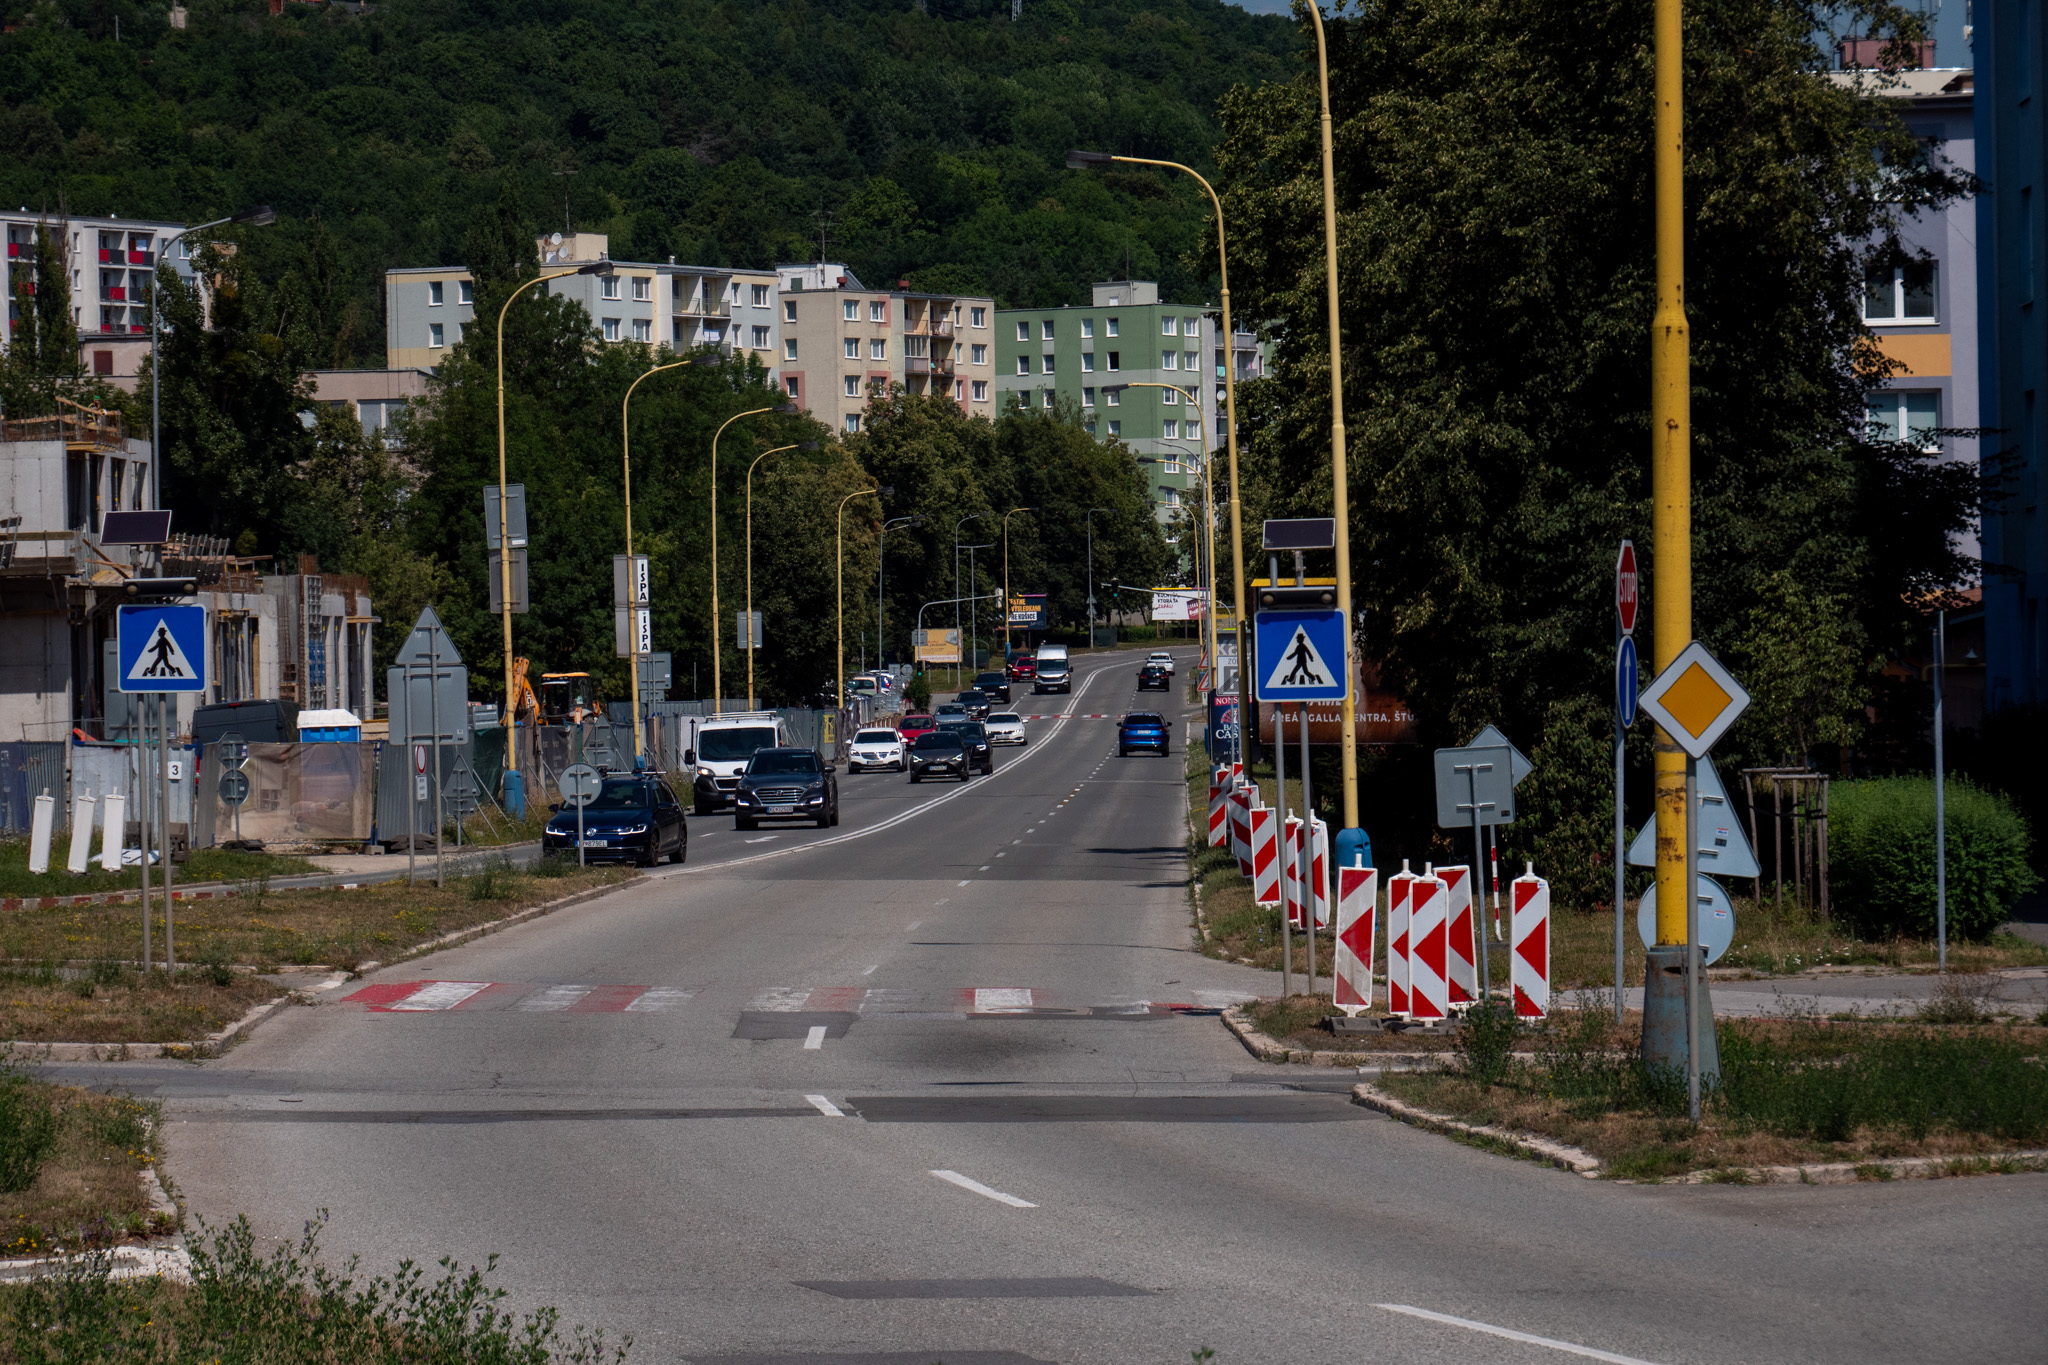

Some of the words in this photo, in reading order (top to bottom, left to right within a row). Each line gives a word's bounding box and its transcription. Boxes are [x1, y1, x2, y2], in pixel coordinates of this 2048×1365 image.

[1620, 571, 1636, 603] STOP
[641, 615, 649, 651] ISPA
[1308, 713, 1342, 722] GALLA
[1354, 713, 1391, 723] ENTRA,
[171, 764, 179, 776] 3
